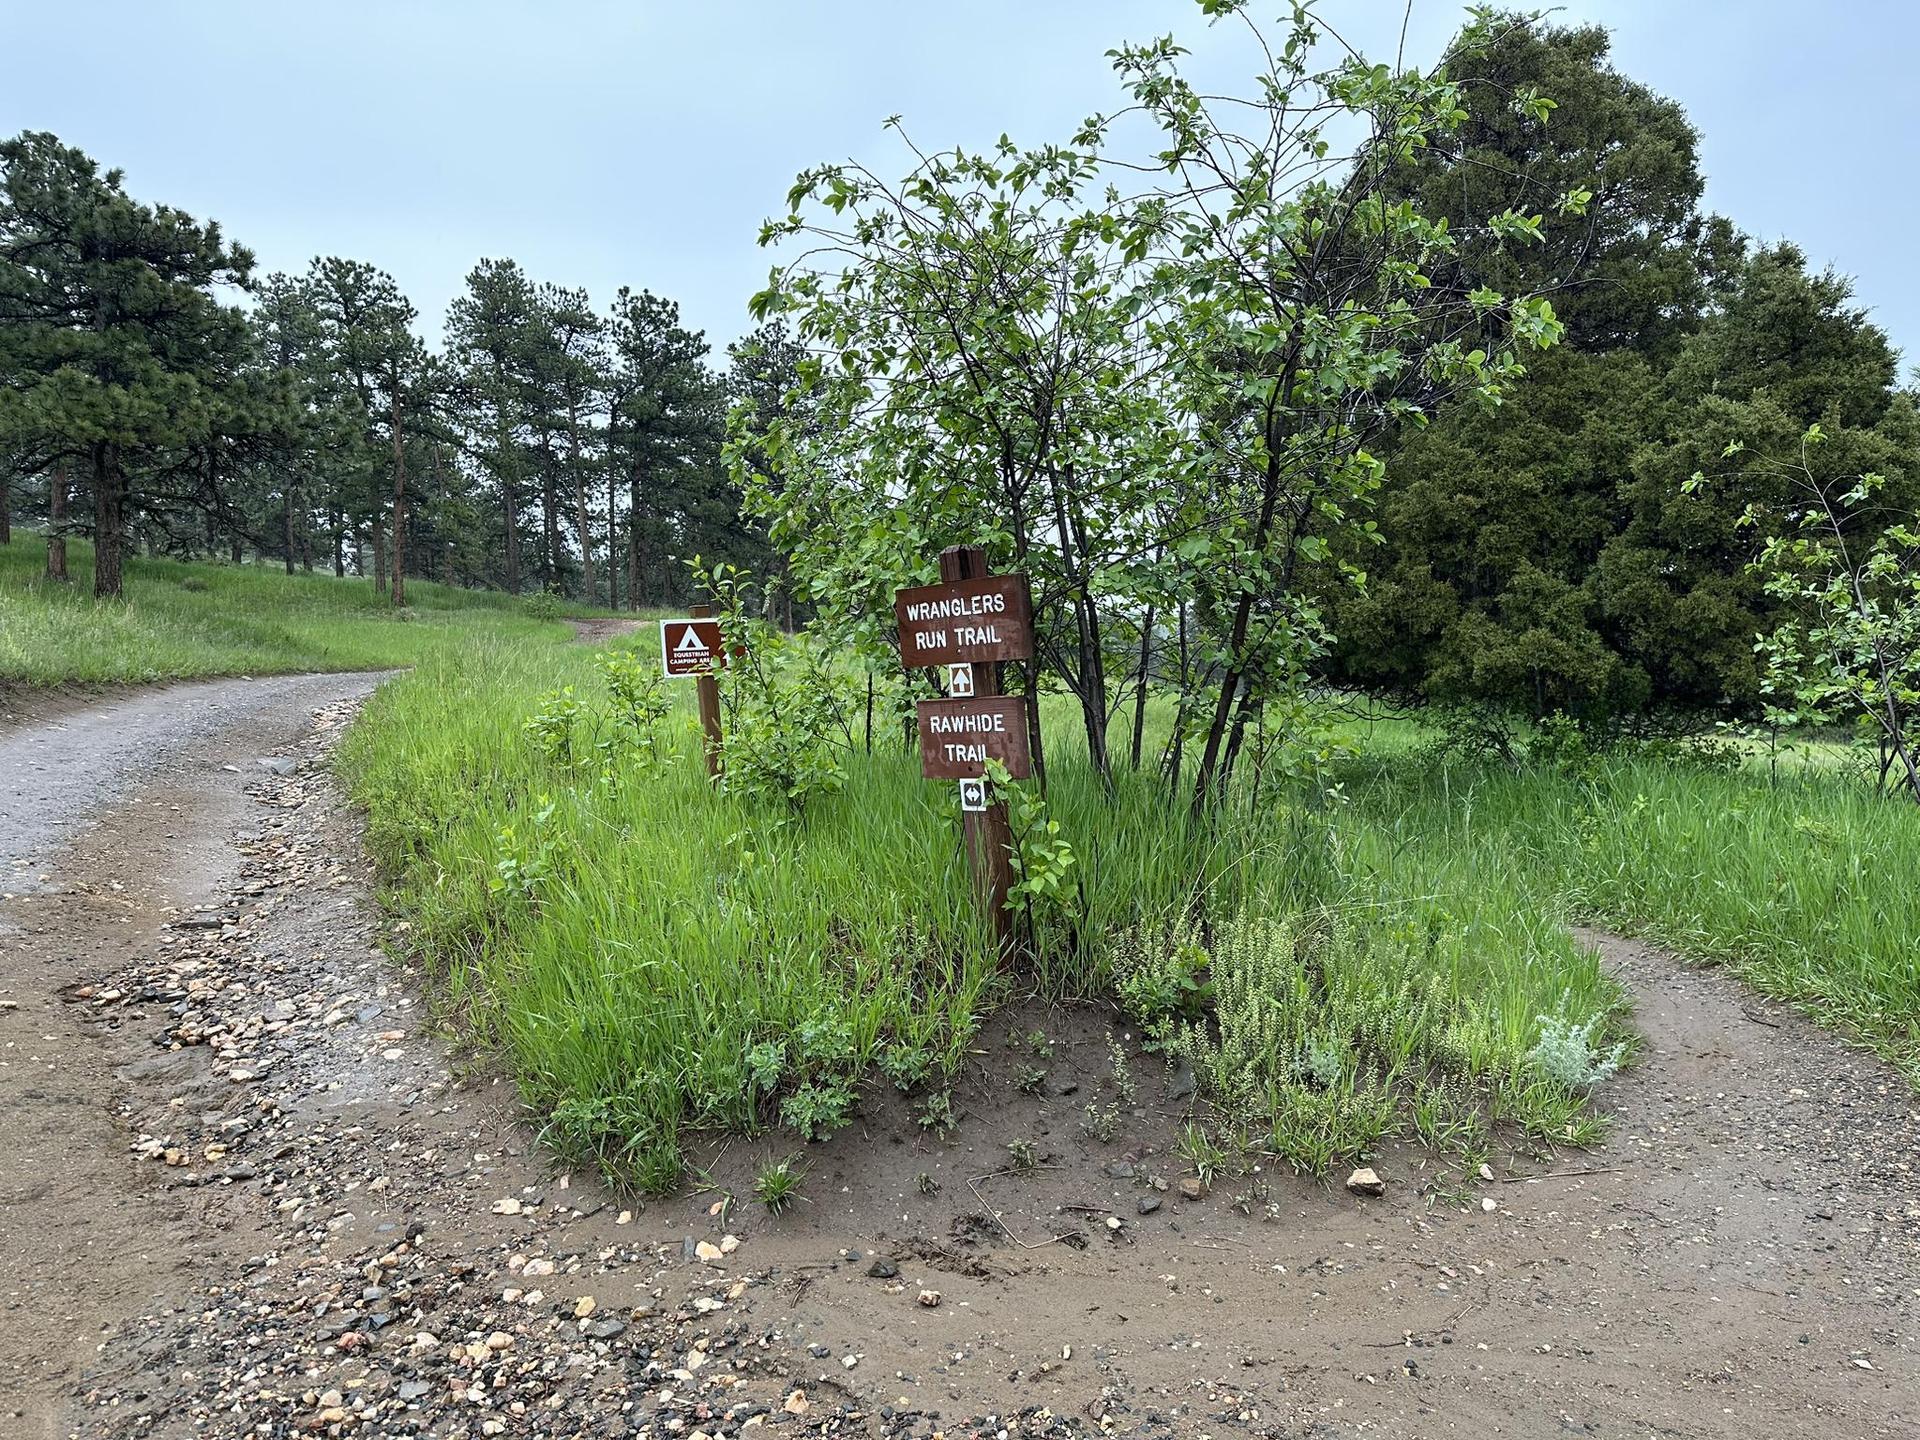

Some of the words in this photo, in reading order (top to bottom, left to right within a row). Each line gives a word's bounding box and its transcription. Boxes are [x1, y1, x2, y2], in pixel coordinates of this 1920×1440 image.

[906, 593, 1005, 622] WRANGLERS
[915, 630, 947, 650] RUN
[954, 625, 1002, 646] TRAIL
[930, 713, 1005, 734] RAWHIDE
